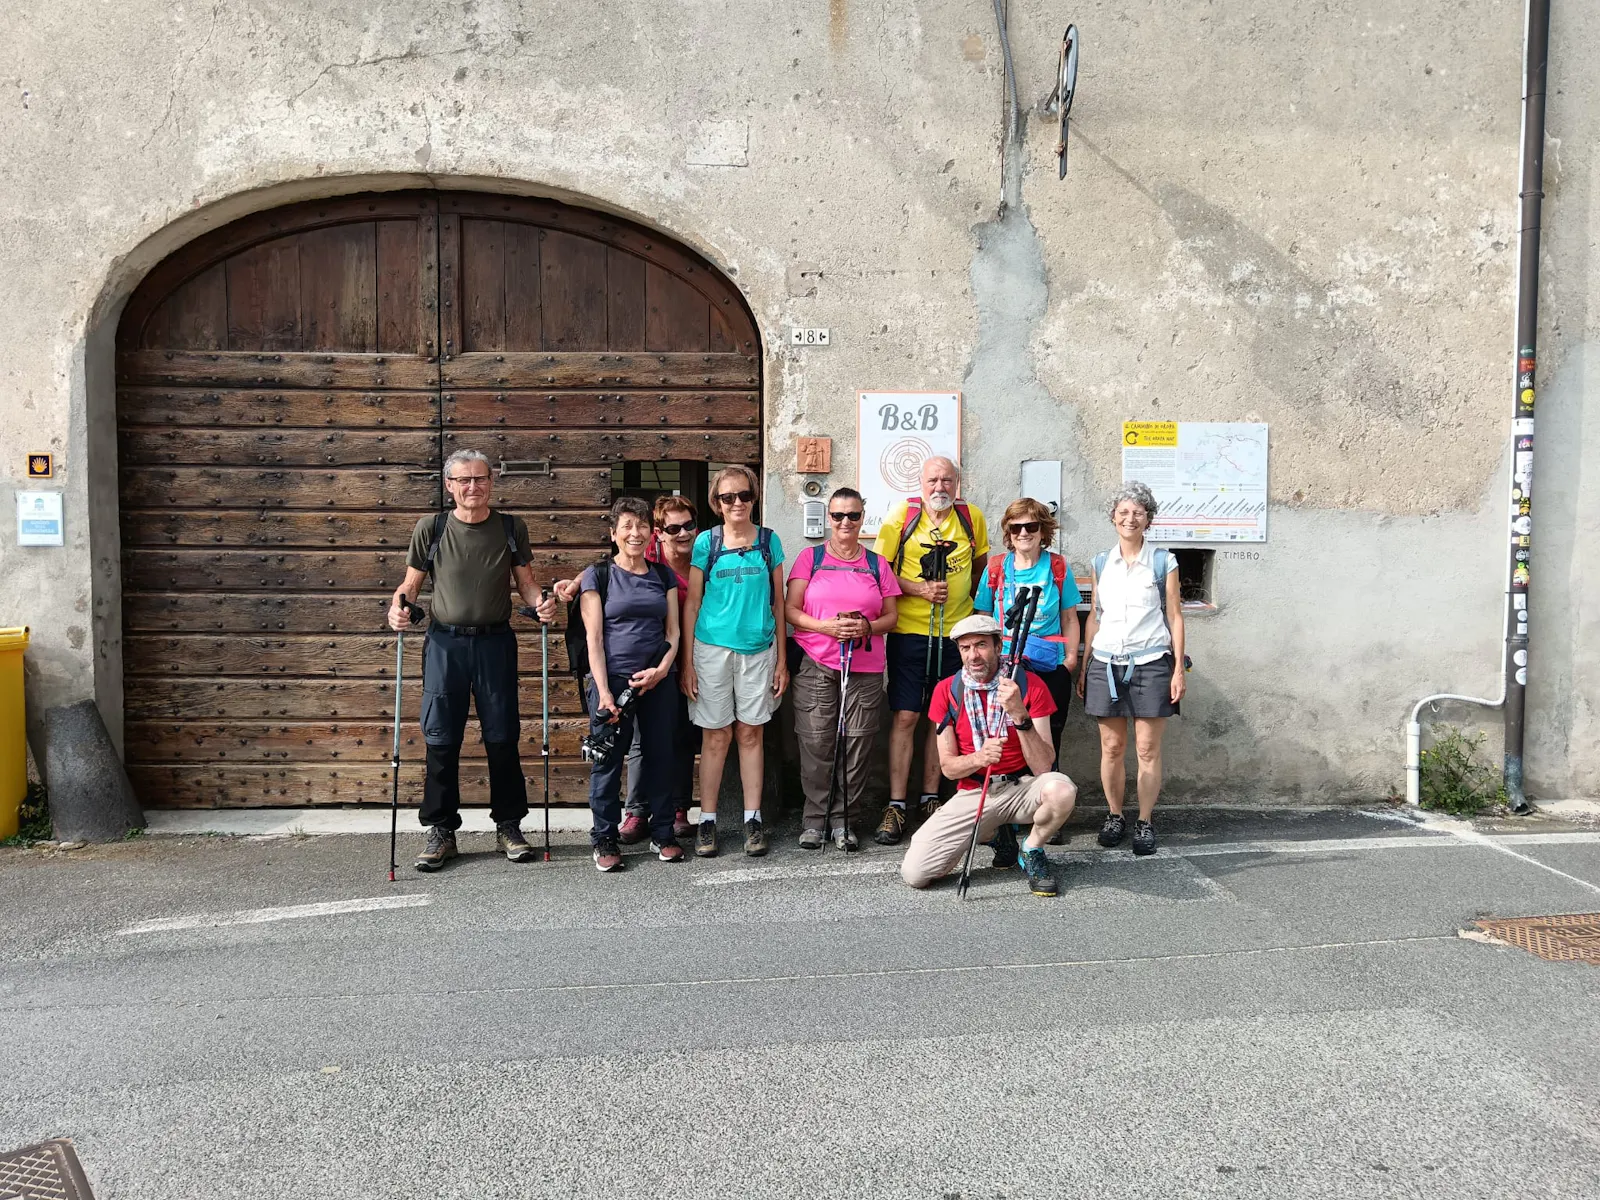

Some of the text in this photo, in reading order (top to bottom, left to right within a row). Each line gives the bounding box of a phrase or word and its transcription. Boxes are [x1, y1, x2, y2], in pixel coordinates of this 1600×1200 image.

[807, 330, 815, 344] 8
[878, 403, 939, 431] B&B
[1223, 551, 1260, 561] TIMBRO
